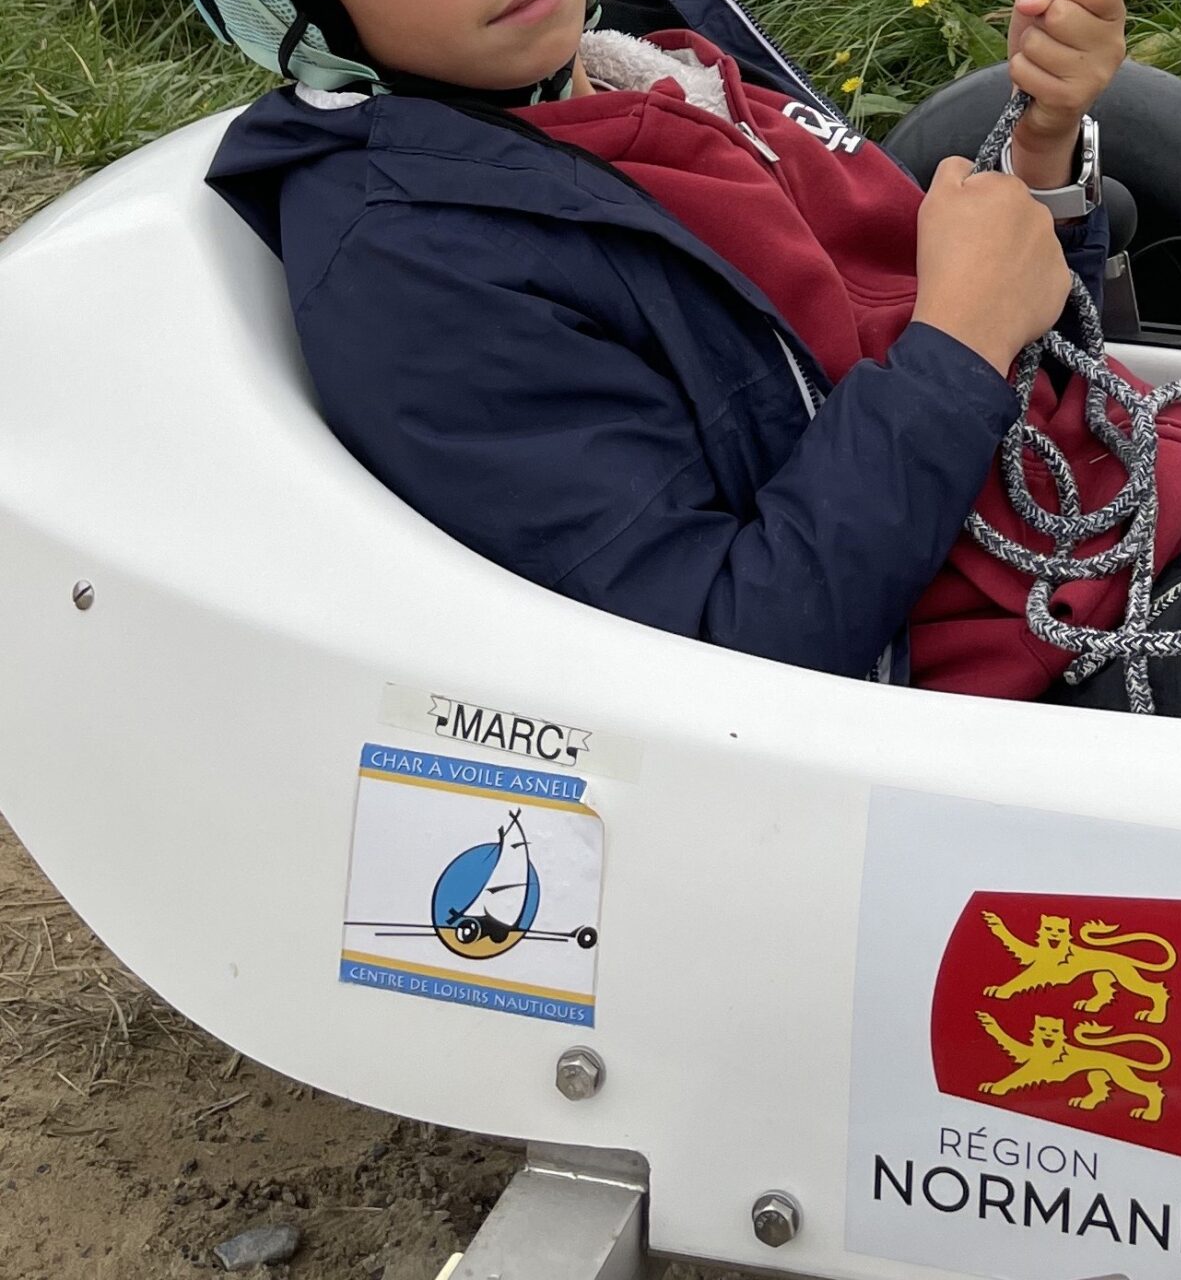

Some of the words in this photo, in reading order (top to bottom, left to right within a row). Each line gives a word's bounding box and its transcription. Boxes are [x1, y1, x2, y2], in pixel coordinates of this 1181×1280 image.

[452, 704, 564, 760] MARC
[370, 751, 423, 774] CHAR
[429, 756, 443, 778] À
[450, 763, 503, 788] VOILE
[350, 967, 405, 989] CENTRE
[410, 978, 429, 993] DE
[434, 982, 489, 1004] LOISIRS
[494, 993, 585, 1021] NAUTIQUES
[939, 1125, 1098, 1180] RÉGION
